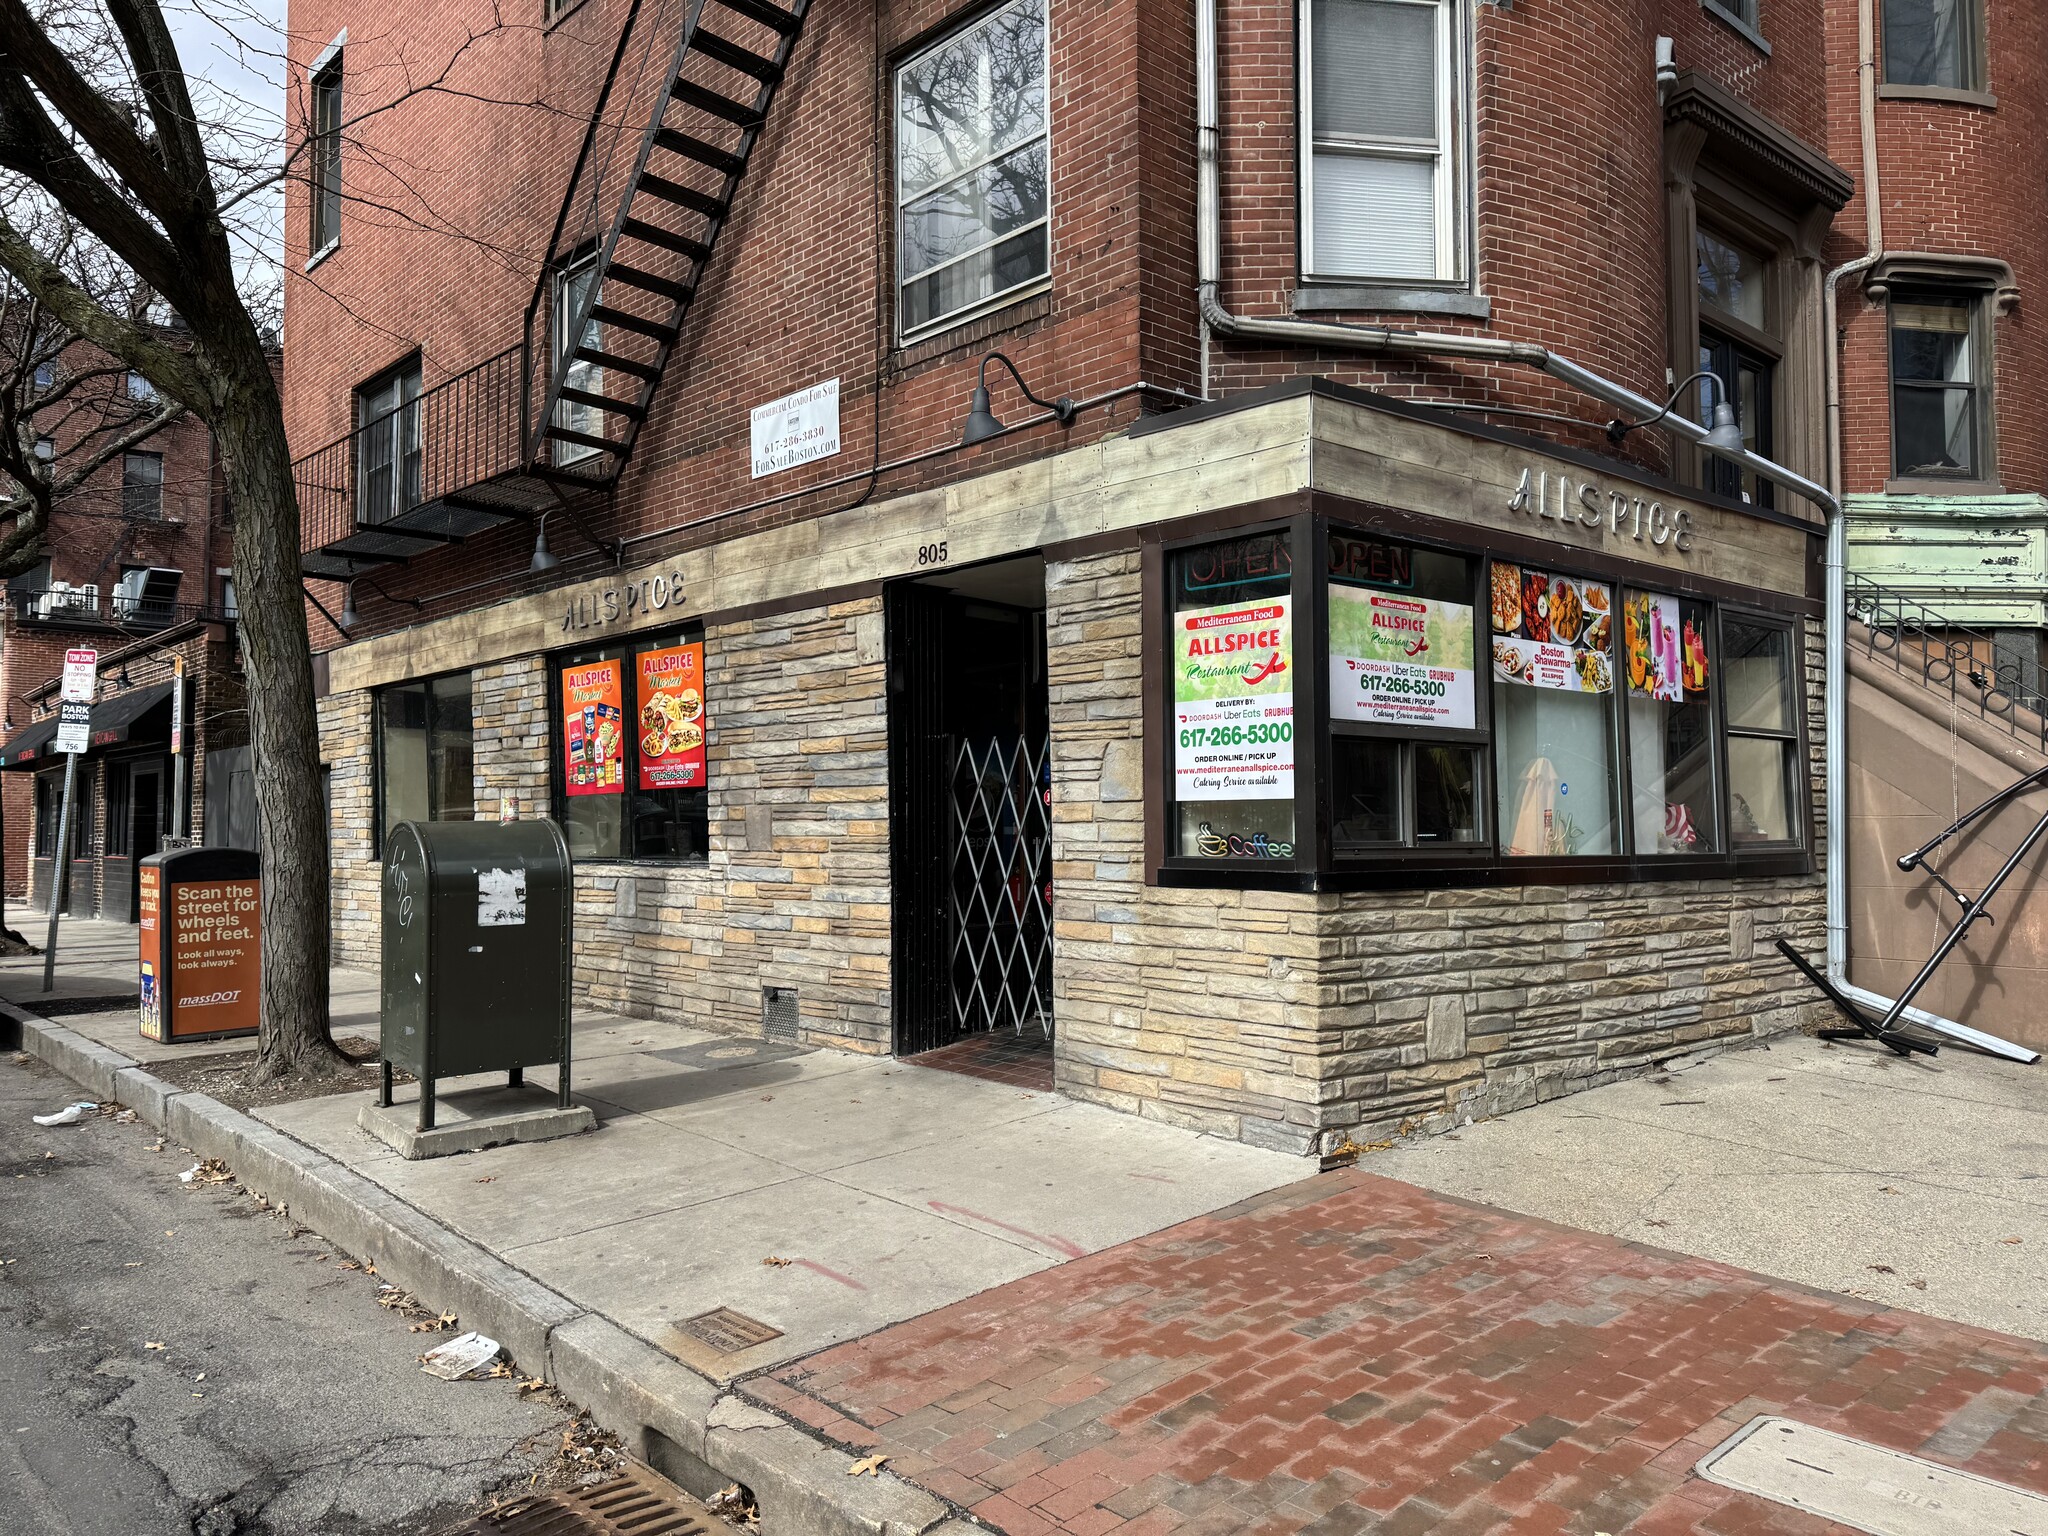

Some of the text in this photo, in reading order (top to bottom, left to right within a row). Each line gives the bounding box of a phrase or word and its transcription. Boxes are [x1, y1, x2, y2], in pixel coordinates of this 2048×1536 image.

[788, 395, 809, 410] CONDO
[809, 389, 822, 403] FOR
[822, 384, 837, 398] SALE
[764, 425, 824, 455] 617-286-3830
[1507, 467, 1692, 551] ALLSPICE
[918, 541, 948, 565] 805
[1328, 536, 1410, 580] OPEN
[560, 570, 687, 631] ALLSPICE
[1377, 598, 1422, 612] Mediterranean Food
[1197, 608, 1274, 628] Mediterranean Food
[1372, 612, 1425, 632] ALLSPICE
[1188, 629, 1280, 657] ALLSPICE
[1371, 631, 1409, 648] Restaurant
[68, 653, 95, 662] TOW ZONE
[1540, 645, 1565, 659] Boston
[644, 653, 693, 675] ALLSPICE
[1534, 654, 1571, 669] Shawarma
[568, 669, 612, 689] ALLSPICE
[1186, 661, 1252, 680] Restaurant
[1356, 662, 1455, 682] DOORDASH Uber Eats GRUBHUB
[1360, 673, 1445, 697] 617-266-5300
[1215, 699, 1244, 708] DELIVERY
[1356, 701, 1450, 715] www.mediterraneanallspice.com
[1372, 694, 1392, 702] ORDER
[1391, 696, 1412, 704] ONLINE
[1414, 698, 1428, 706] PICK
[62, 704, 90, 714] PARK
[1189, 707, 1294, 722] DOORDASH Uber Eats GRUBHUB
[1372, 708, 1435, 721] Catering Service available
[1180, 722, 1293, 748] 617-266-5300
[1194, 755, 1218, 763] ORDER
[1218, 754, 1243, 762] ONLINE
[1266, 752, 1277, 760] UP
[650, 769, 694, 781] 617-266-5300
[1193, 775, 1278, 790] Catering Service available
[1228, 834, 1295, 858] Coffee
[178, 885, 253, 901] Scan the
[177, 898, 258, 915] street for
[177, 913, 240, 930] wheels
[177, 926, 254, 944] and feet.
[178, 947, 245, 960] Look all ways,
[178, 959, 238, 970] look always.
[178, 990, 242, 1006] massDOT
